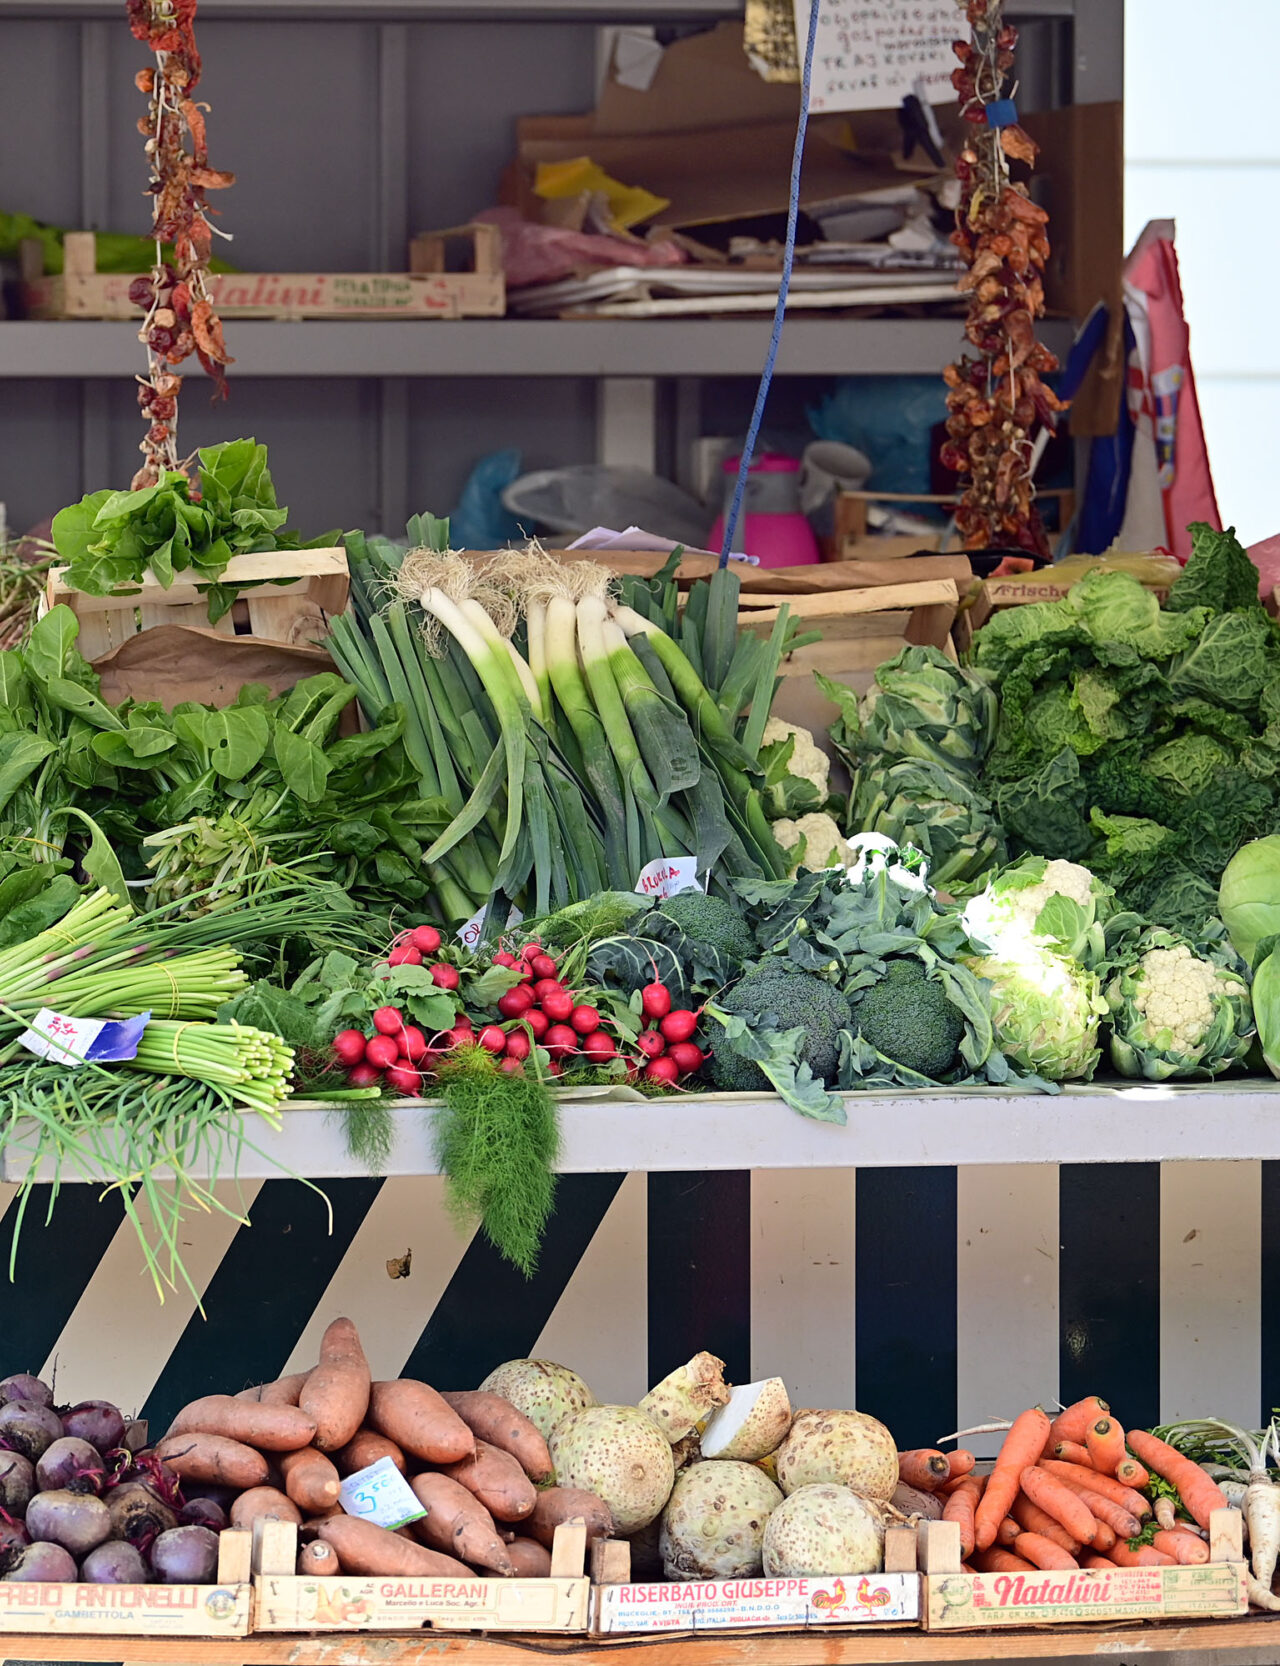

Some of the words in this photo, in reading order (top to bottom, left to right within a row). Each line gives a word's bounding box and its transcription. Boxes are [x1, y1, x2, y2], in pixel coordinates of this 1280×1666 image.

[75, 1585, 198, 1609] ANTONELLI
[380, 1583, 488, 1599] GALLERANI
[619, 1583, 718, 1604] RISERBATO
[722, 1579, 809, 1600] GIUSEPPE
[993, 1573, 1112, 1607] Natalini
[54, 1609, 134, 1620] GAMBETTOLA
